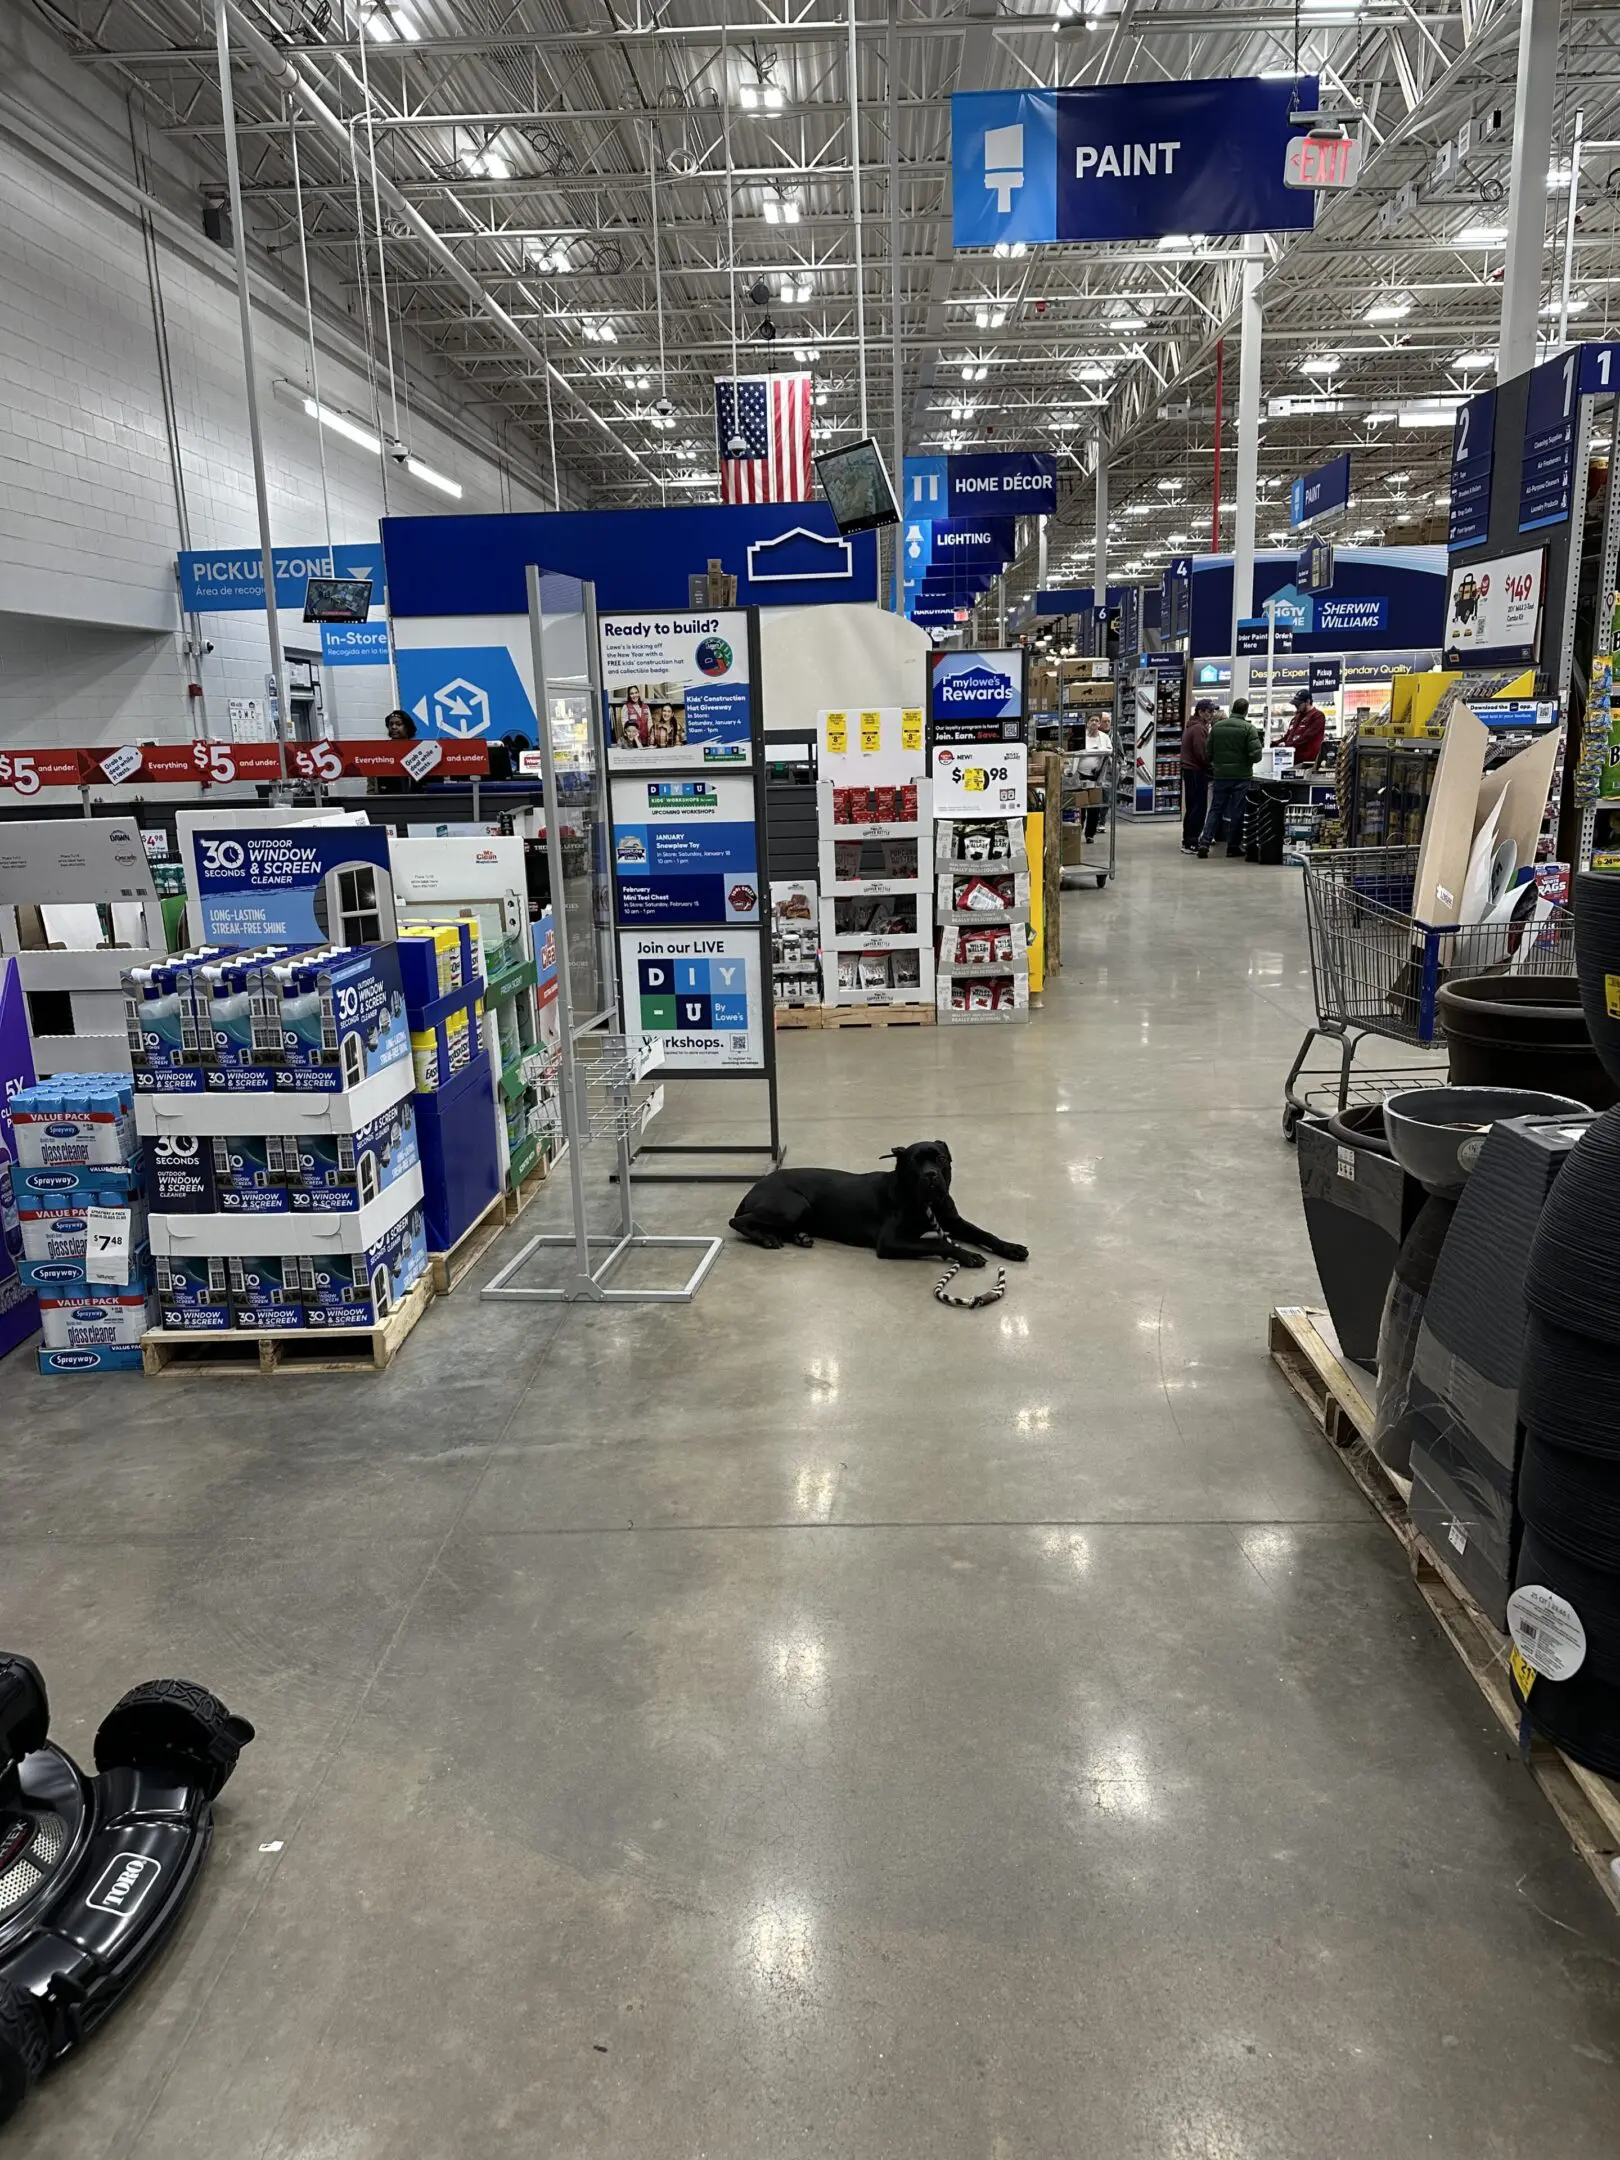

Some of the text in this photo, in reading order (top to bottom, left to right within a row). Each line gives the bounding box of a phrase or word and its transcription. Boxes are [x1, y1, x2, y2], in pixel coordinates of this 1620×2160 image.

[1076, 142, 1181, 178] PAINT
[1299, 138, 1353, 184] EXIT
[1597, 350, 1611, 385] 1
[1562, 355, 1575, 417] 1
[1456, 408, 1470, 461] 2
[955, 472, 1053, 492] HOME DÉCOR
[1305, 484, 1321, 506] PAINT
[937, 533, 992, 546] LIGHTING
[276, 558, 333, 578] ZONE
[1176, 561, 1188, 576] 4
[1505, 574, 1532, 602] $149
[1099, 608, 1106, 620] 6
[1322, 602, 1380, 614] SHERWIN
[1321, 615, 1379, 628] WILLIAMS
[605, 620, 719, 638] Ready to build?
[326, 632, 387, 645] In-Store
[1380, 665, 1412, 676] Quality
[953, 676, 1000, 688] mylowe's
[943, 685, 1013, 702] Rewards
[936, 731, 1000, 740] Join. Earn. Save.
[104, 758, 118, 770] Grab
[194, 743, 279, 783] $5 and under.
[296, 740, 395, 780] $5 Everything
[405, 754, 418, 766] Grab
[148, 762, 188, 771] Everything
[0, 754, 77, 794] $5 and under.
[202, 840, 292, 869] 30 OUTDOOR
[250, 848, 316, 862] WINDOW
[204, 869, 246, 878] SECONDS
[250, 862, 322, 874] & SCREEN
[251, 876, 292, 884] CLEANER
[622, 886, 650, 894] February
[1538, 882, 1566, 896] RAGS
[210, 909, 266, 921] LONG-LASTING
[212, 922, 286, 934] STREAK-FREE SHINE
[638, 941, 724, 954] Join our LIVE
[358, 980, 384, 1001] WINDOW
[336, 986, 358, 1020] 30
[365, 992, 387, 1010] SCREEN
[715, 1003, 726, 1012] By
[340, 1014, 360, 1029] SECONDS
[716, 1012, 744, 1021] Lowe's
[642, 1036, 724, 1048] Wrkshops.
[276, 1072, 292, 1084] 30
[295, 1072, 333, 1080] WINDOW
[30, 1114, 63, 1122] VALUE
[50, 1127, 75, 1136] Sprayway
[42, 1142, 90, 1164] glass cleaner
[34, 1176, 72, 1186] Sprayway
[158, 1176, 201, 1184] WINDOW
[167, 1184, 204, 1192] SCREEN
[36, 1210, 68, 1218] VALUE
[56, 1222, 83, 1230] Sprayway
[48, 1238, 68, 1258] glass
[94, 1234, 122, 1250] $748
[39, 1268, 80, 1278] Sprayway
[92, 1297, 120, 1305] PACK
[76, 1310, 102, 1318] Sprayway
[309, 1311, 325, 1322] 30
[327, 1308, 365, 1316] WINDOW
[68, 1326, 116, 1346] glass cleaner
[56, 1356, 94, 1364] Sprayway
[103, 1860, 145, 1906] TORO
